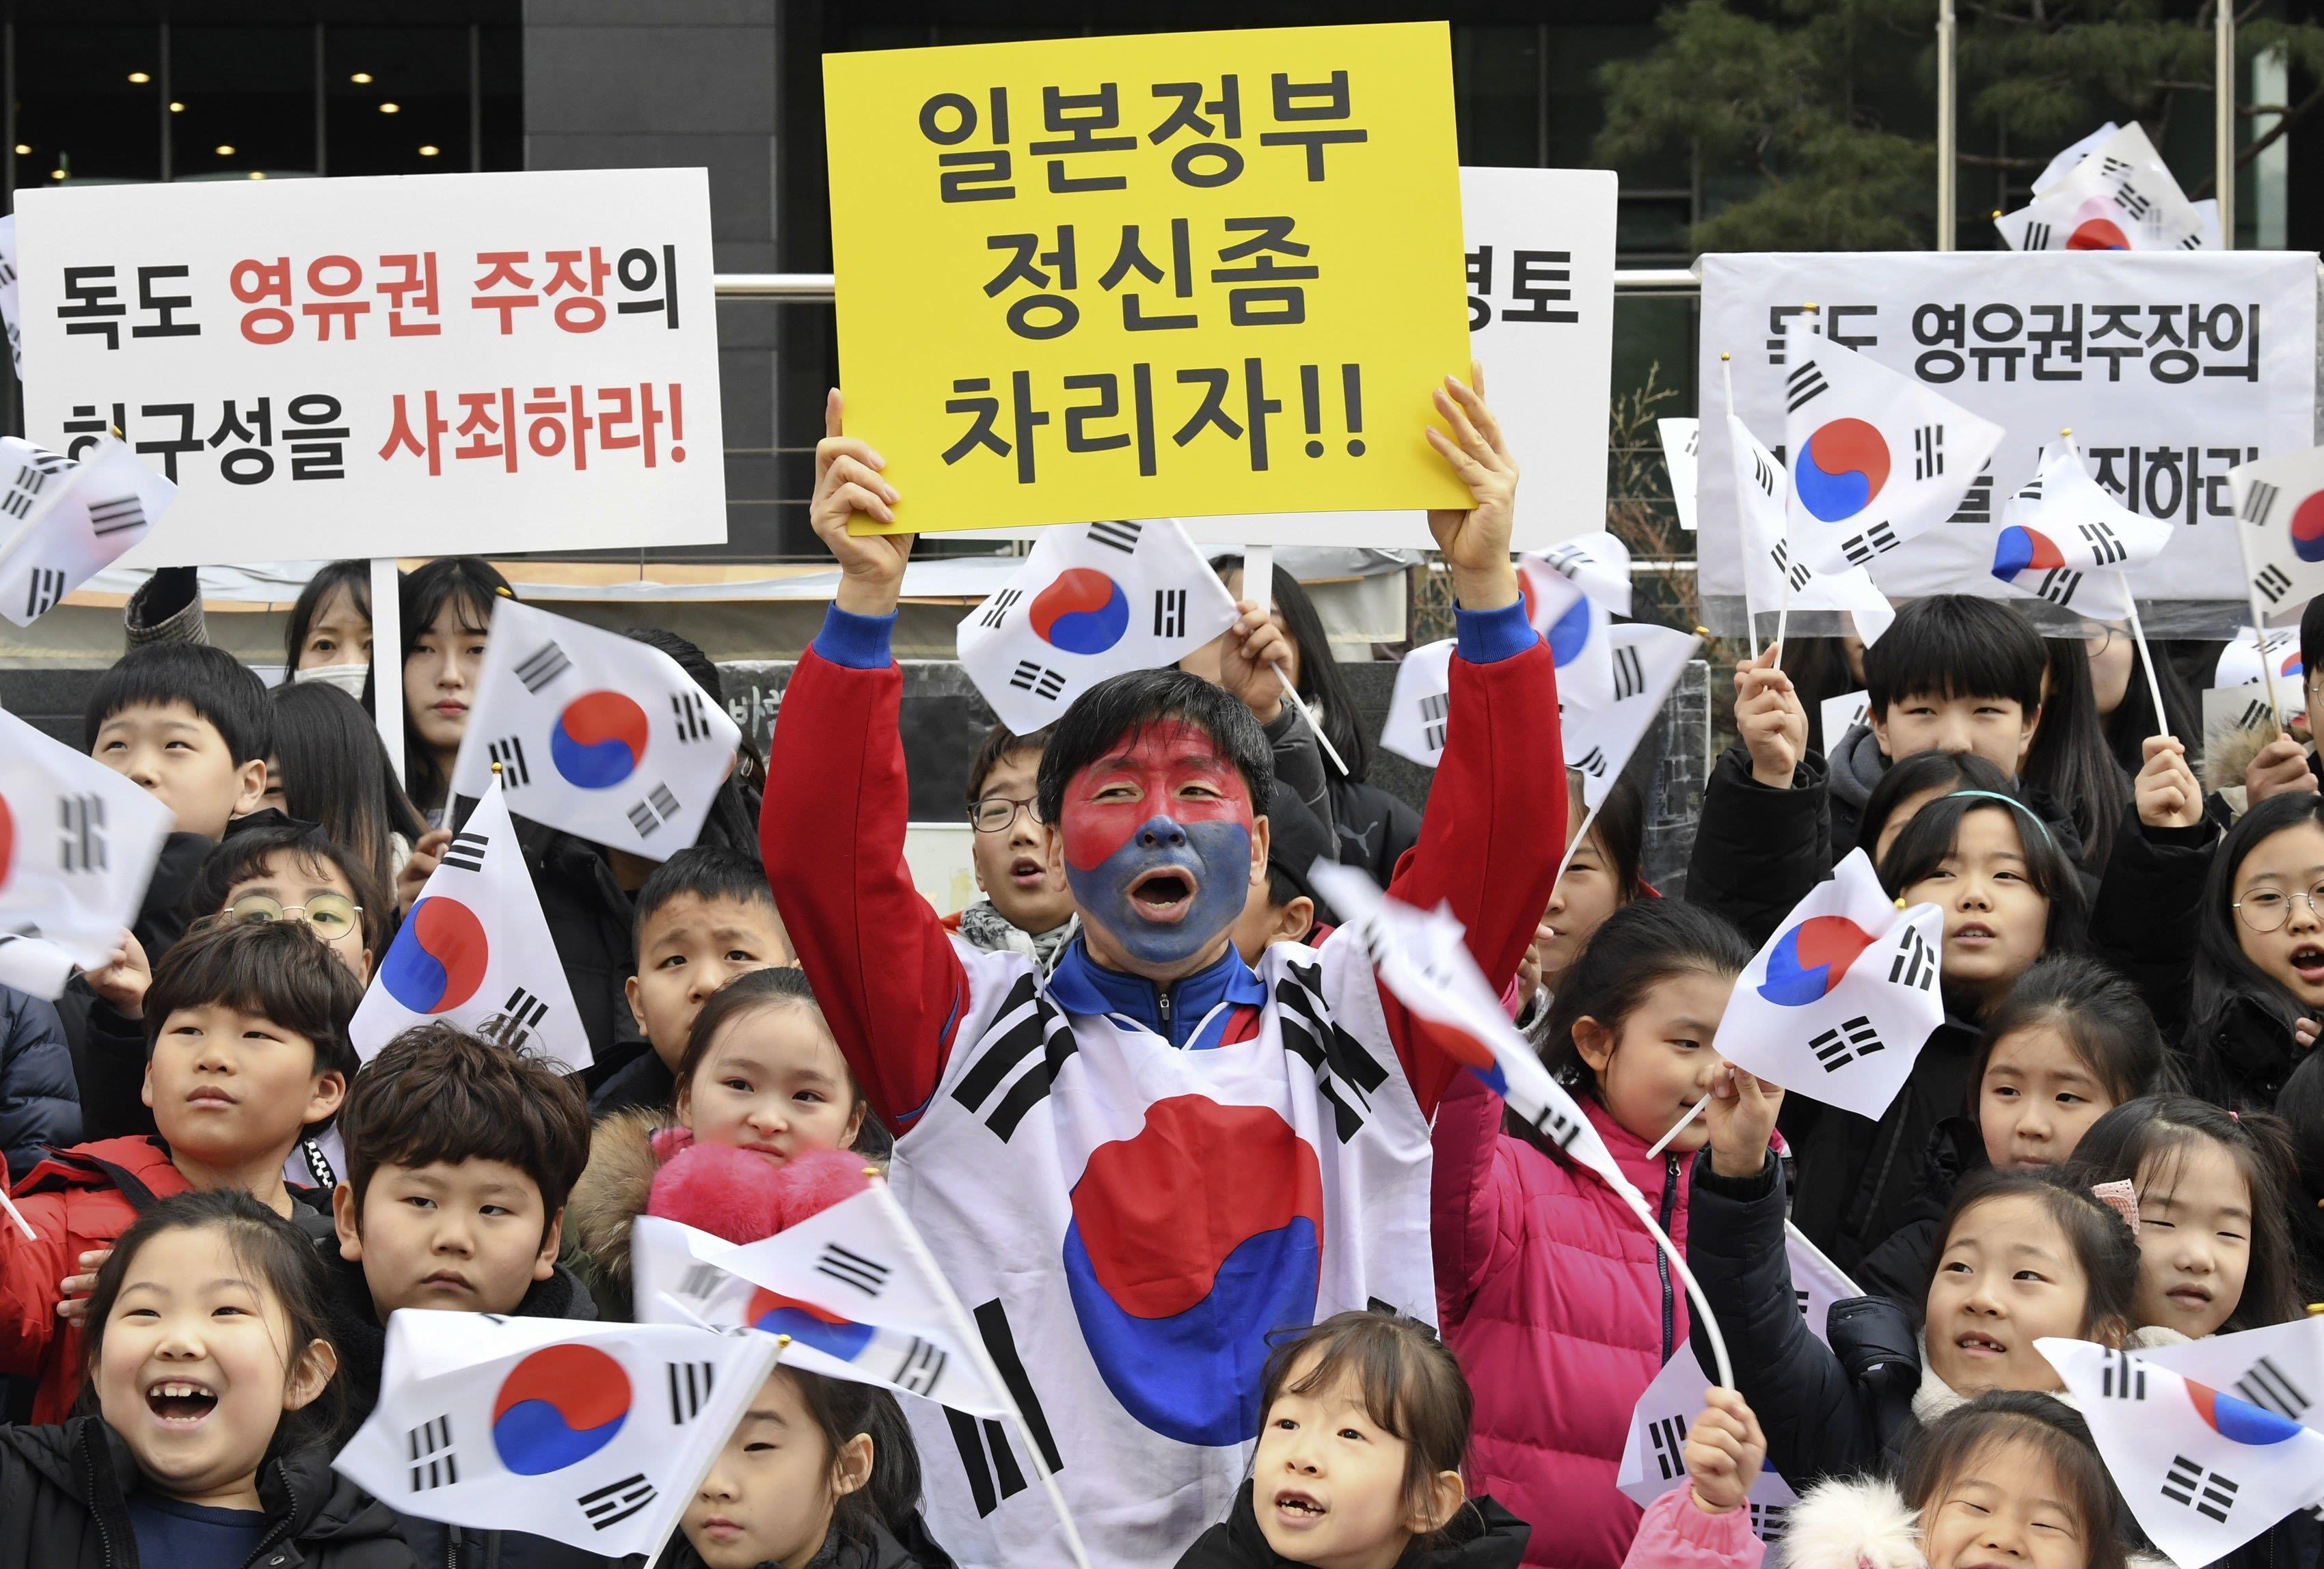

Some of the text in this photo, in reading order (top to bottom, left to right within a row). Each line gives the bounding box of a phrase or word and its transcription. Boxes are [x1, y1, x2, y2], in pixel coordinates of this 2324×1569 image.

[919, 70, 1368, 204] 일본정부
[57, 245, 679, 351] 독도 영유권 주장의
[983, 216, 1319, 340] 정신좀
[378, 383, 686, 477] 사죄하라!
[941, 357, 1366, 485] 차리자!!
